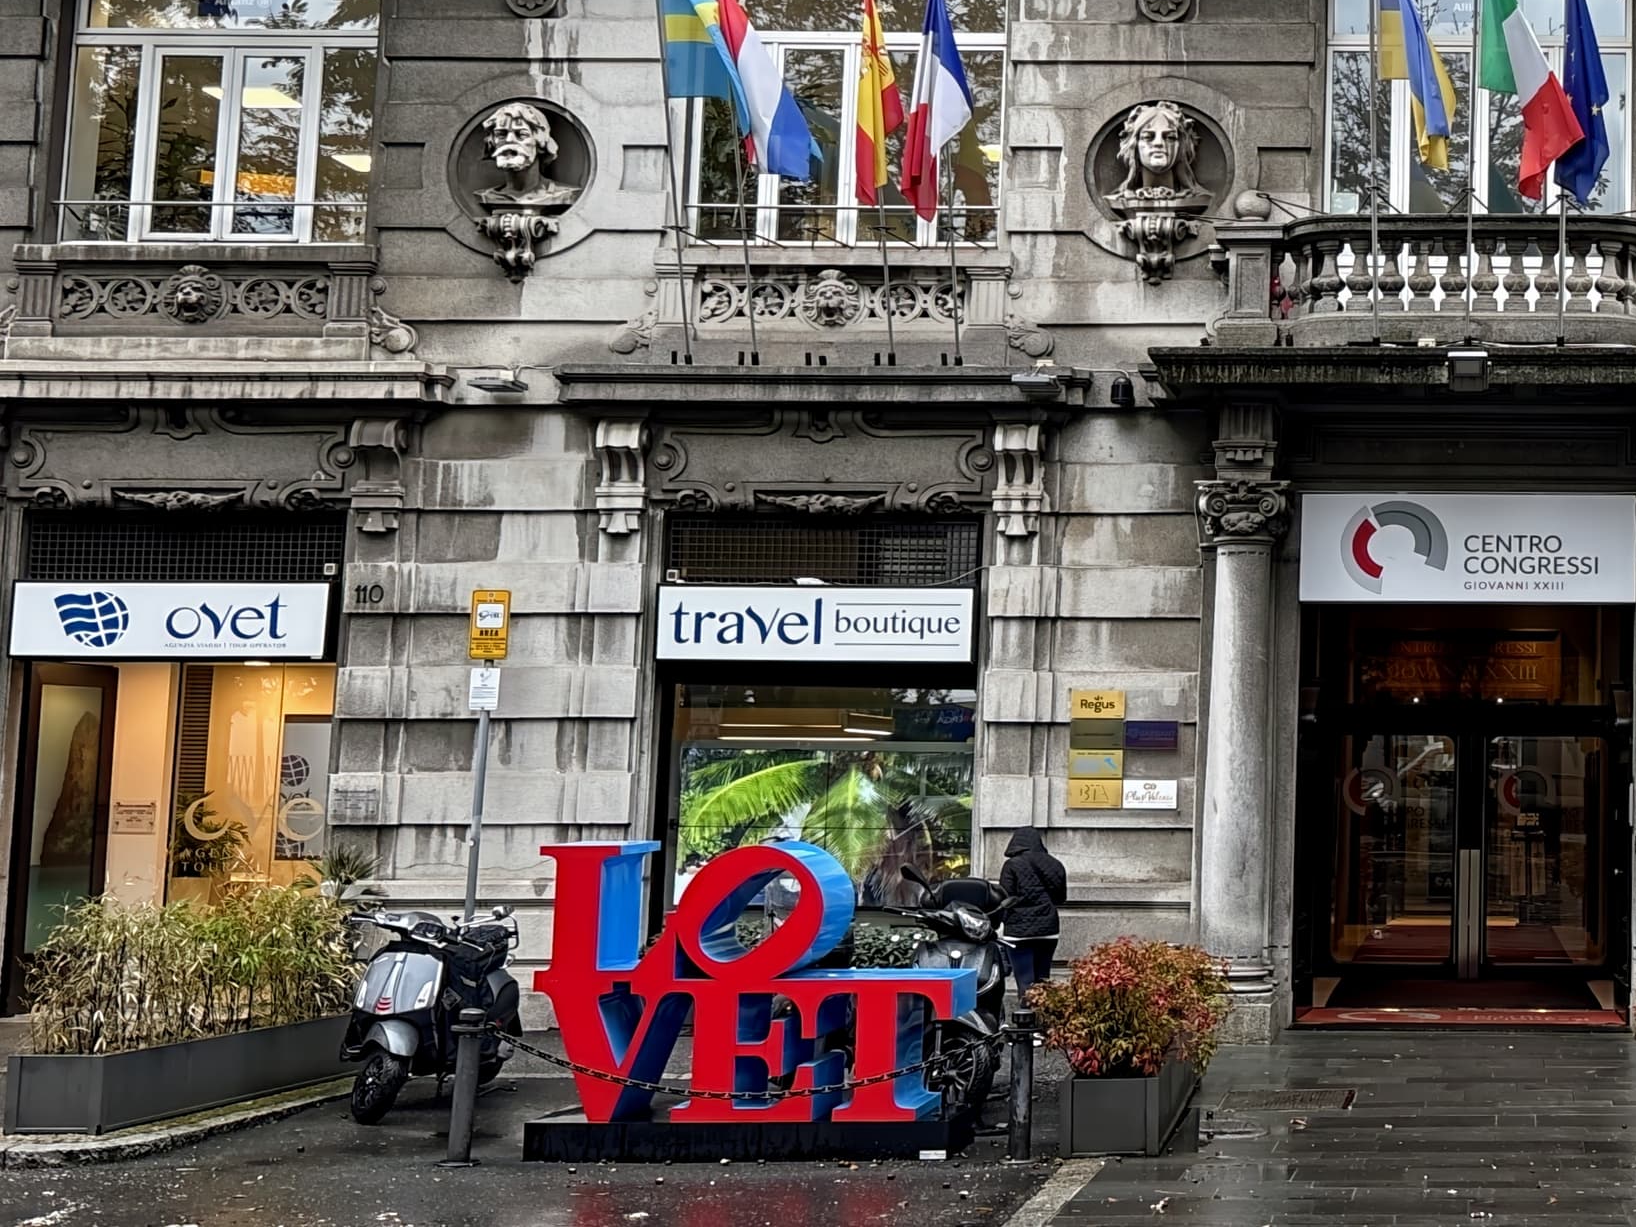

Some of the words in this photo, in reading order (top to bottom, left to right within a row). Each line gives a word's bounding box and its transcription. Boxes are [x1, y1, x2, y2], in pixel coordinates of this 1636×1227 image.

[1463, 535, 1562, 553] CENTRO
[1463, 556, 1599, 575] CONGRESSI
[355, 584, 385, 604] 110
[1463, 581, 1529, 590] GIOVANNI
[1533, 581, 1565, 590] XXIII
[165, 592, 288, 640] ovet
[669, 597, 823, 645] travel
[835, 609, 961, 640] boutique
[1080, 698, 1115, 713] Regus
